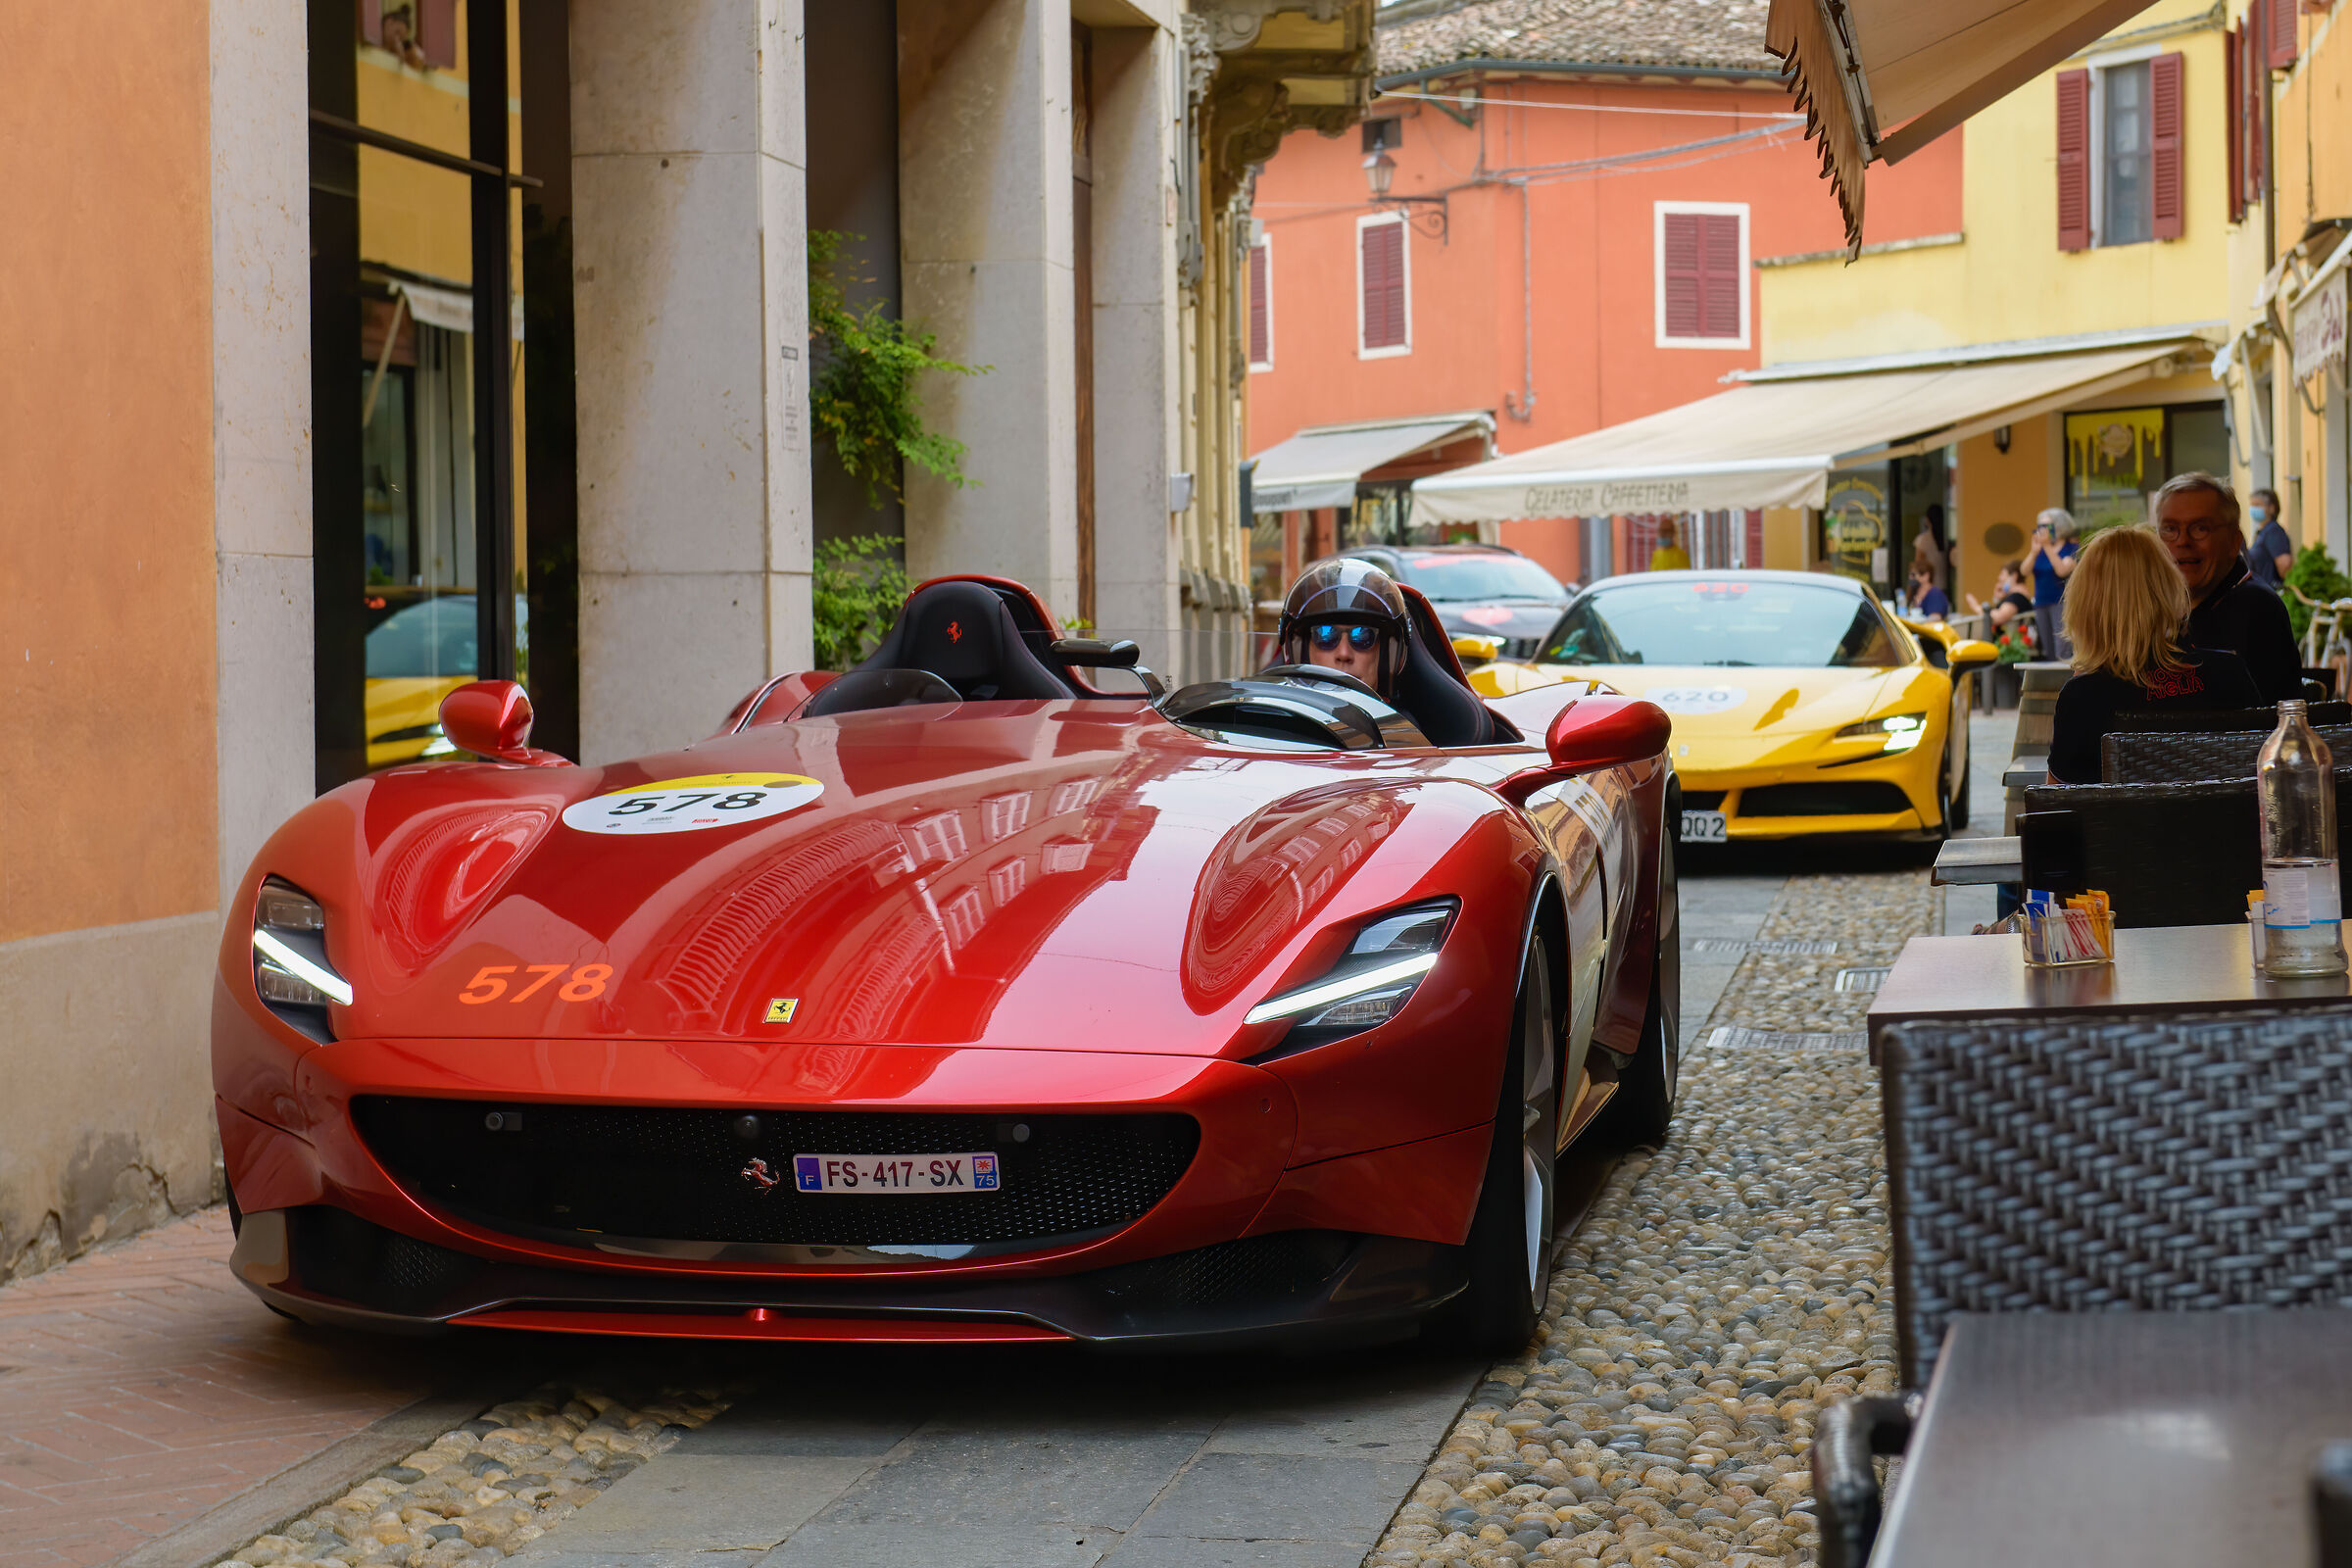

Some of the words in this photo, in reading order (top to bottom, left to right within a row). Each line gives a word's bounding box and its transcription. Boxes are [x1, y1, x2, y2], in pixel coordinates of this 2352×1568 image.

[1691, 582, 1749, 594] 620
[1663, 691, 1729, 703] 620
[608, 792, 768, 815] 578
[458, 963, 614, 1005] 578
[806, 1175, 814, 1186] F
[826, 1159, 965, 1188] FS-417-SX
[976, 1176, 996, 1187] 75
